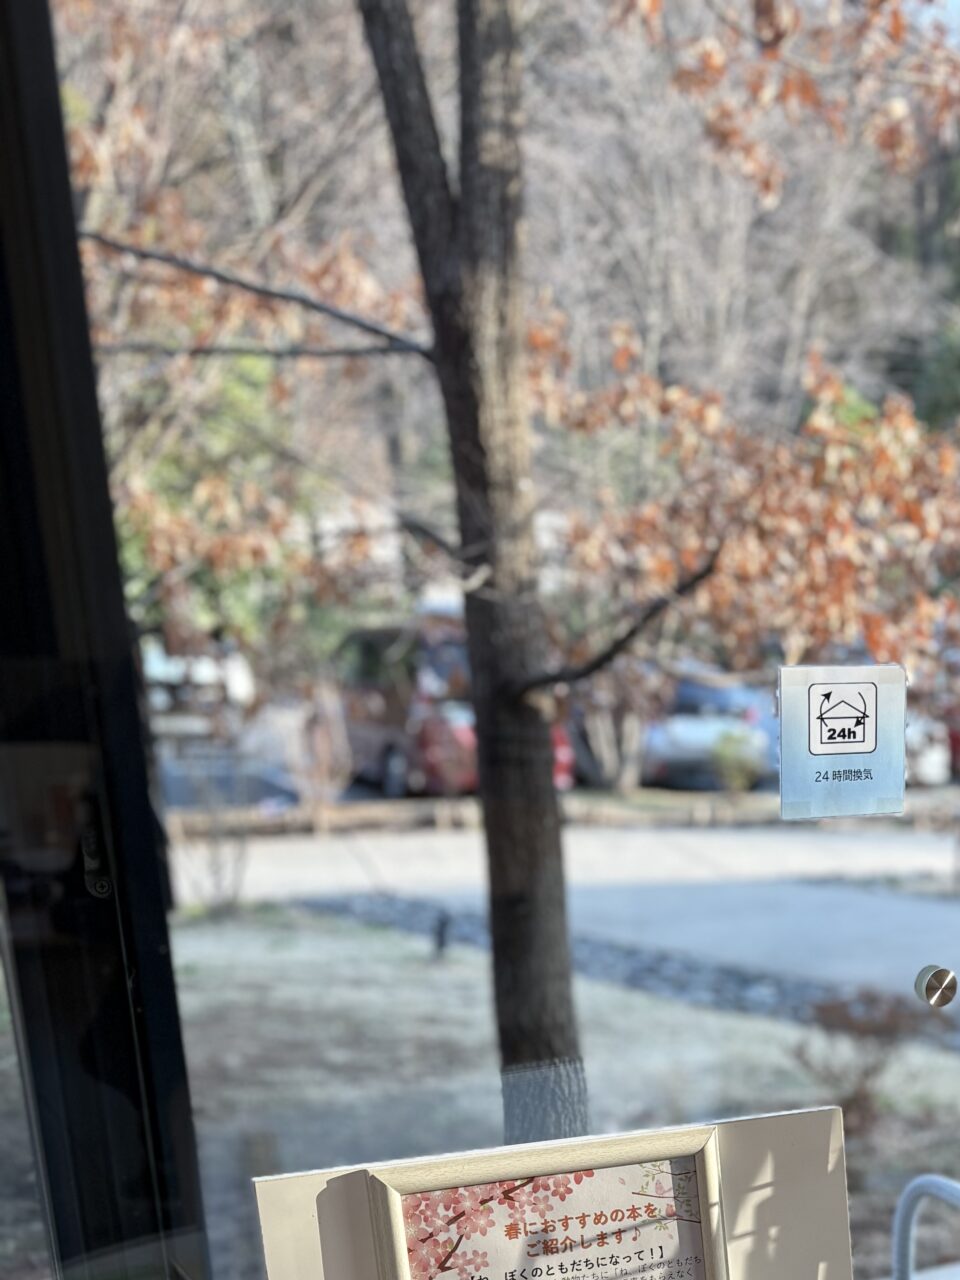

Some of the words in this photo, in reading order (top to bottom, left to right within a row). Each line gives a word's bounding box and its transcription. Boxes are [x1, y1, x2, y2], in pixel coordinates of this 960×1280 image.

[827, 728, 857, 740] 24h
[503, 1201, 657, 1241] 春におすすめの本を
